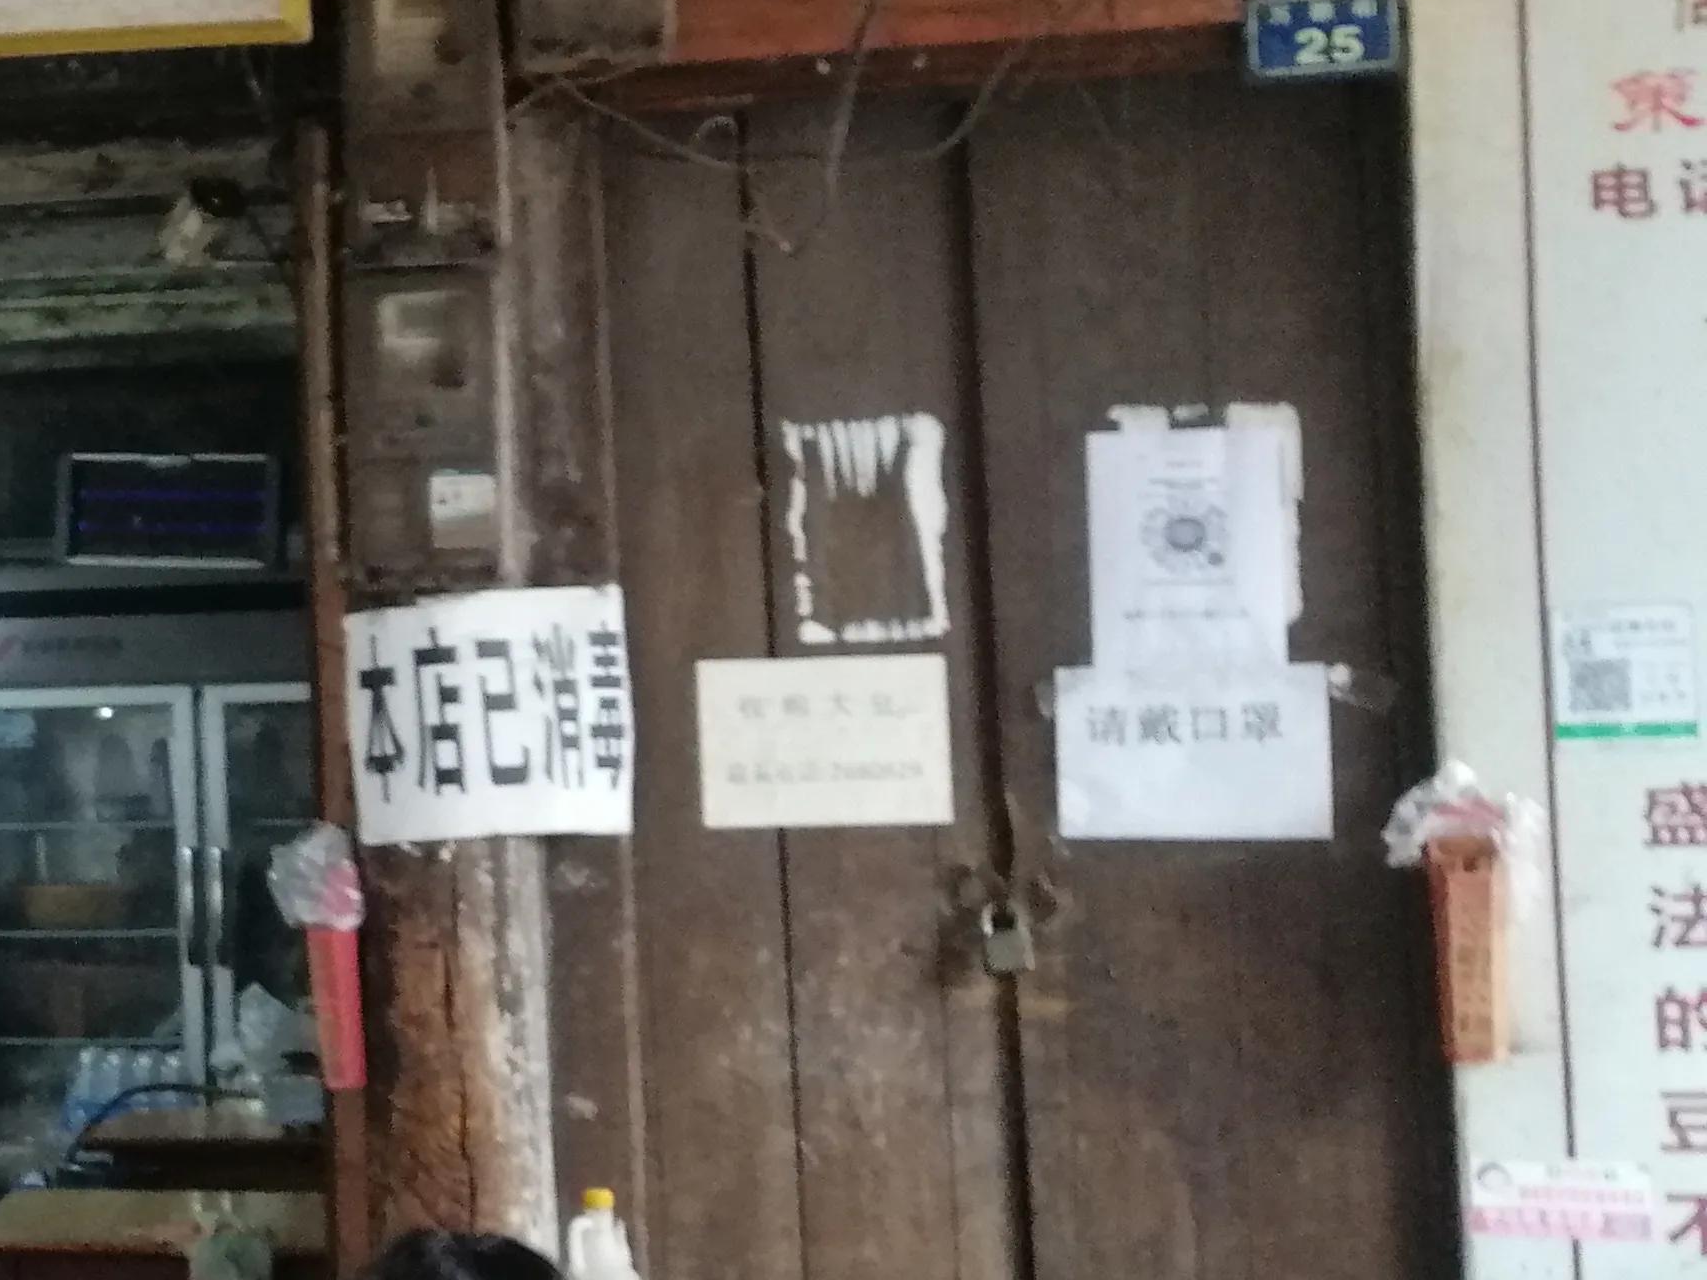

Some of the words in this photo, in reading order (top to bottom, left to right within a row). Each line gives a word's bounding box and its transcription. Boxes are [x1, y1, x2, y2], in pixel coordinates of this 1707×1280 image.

[1294, 23, 1365, 65] 25
[356, 619, 625, 804] 本店已消毒
